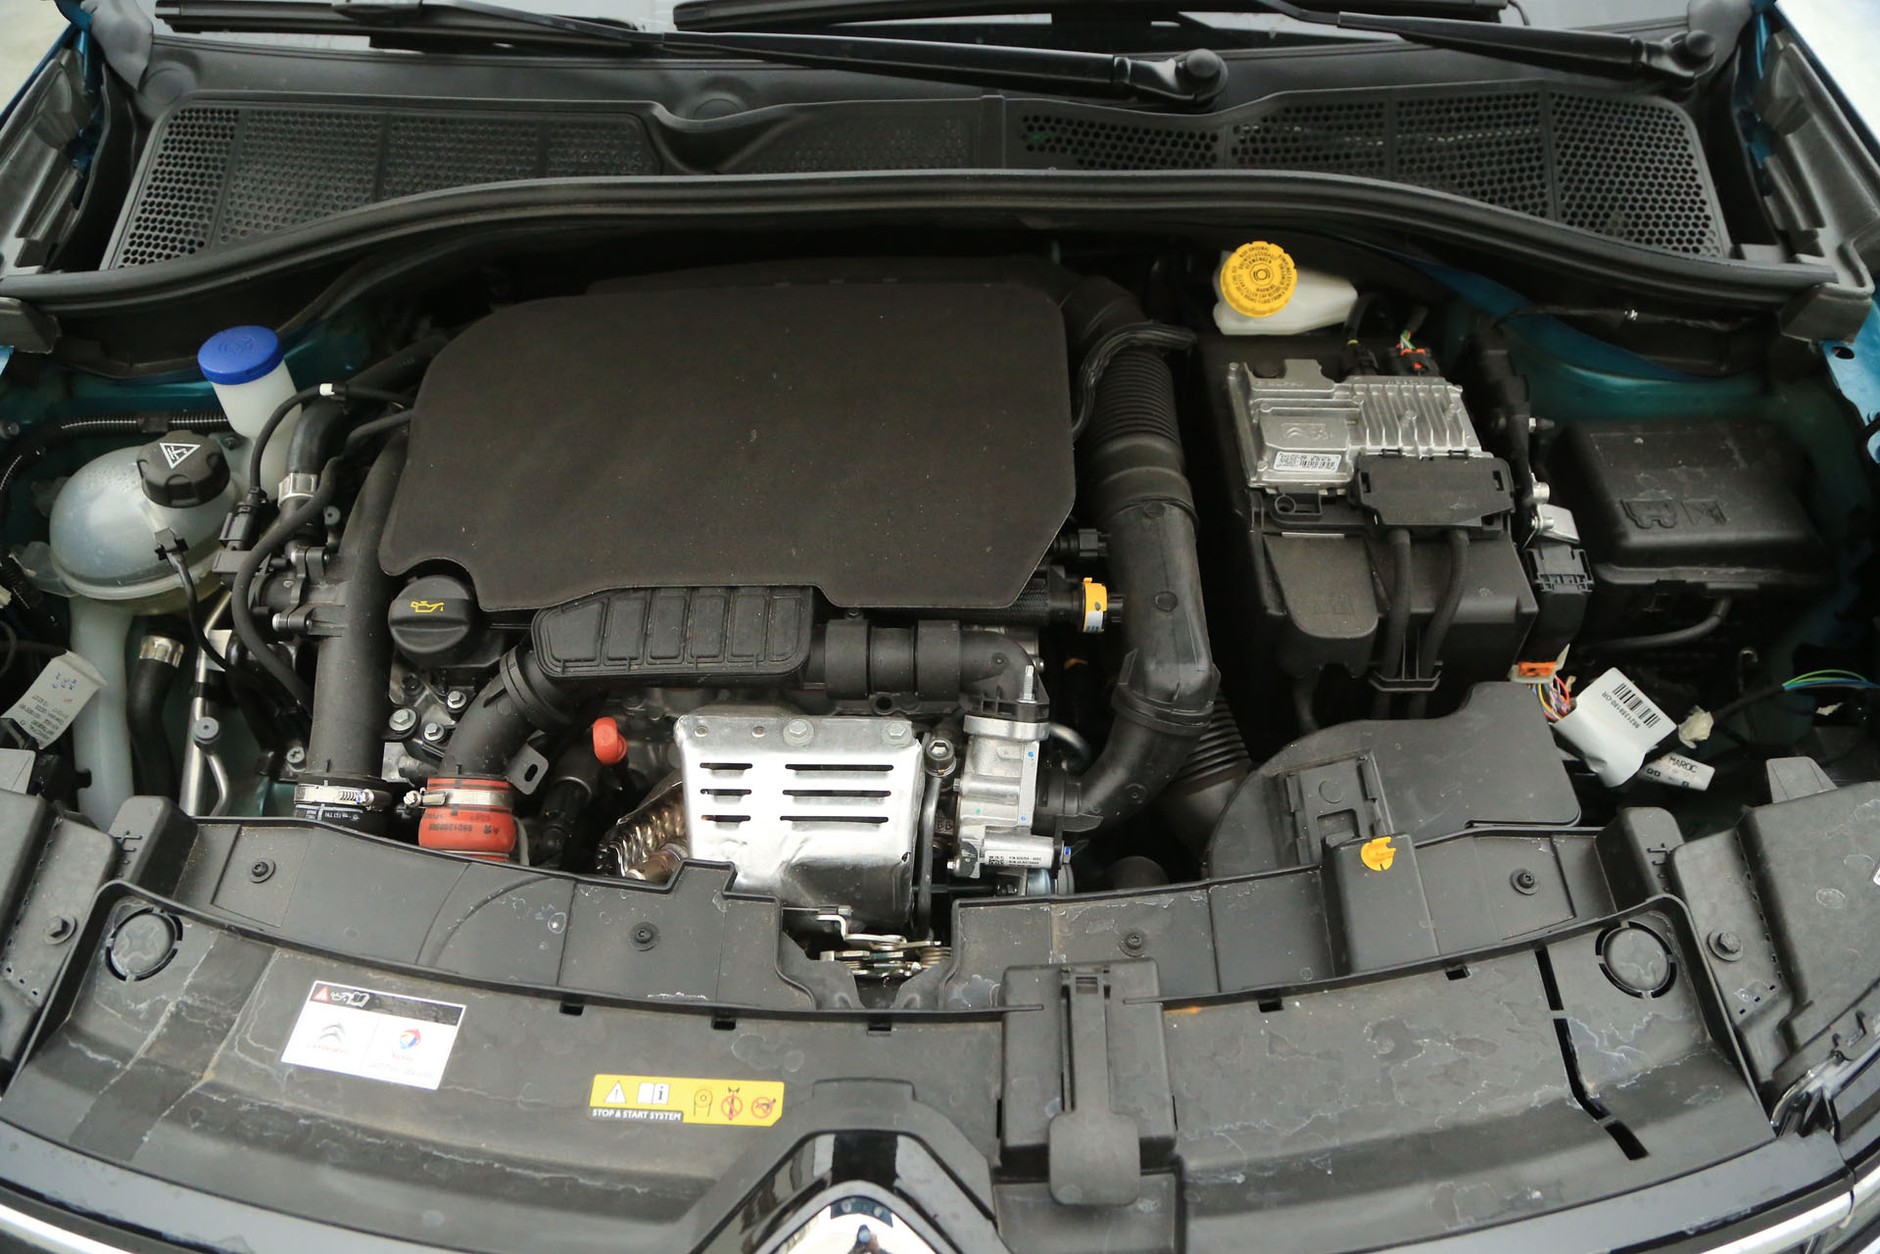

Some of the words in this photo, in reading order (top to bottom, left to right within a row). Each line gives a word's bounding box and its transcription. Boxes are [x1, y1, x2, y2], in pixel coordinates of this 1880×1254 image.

[592, 1108, 615, 1117] STOP
[615, 1109, 621, 1118] &
[623, 1110, 648, 1119] START
[649, 1111, 682, 1121] SYSTEM
